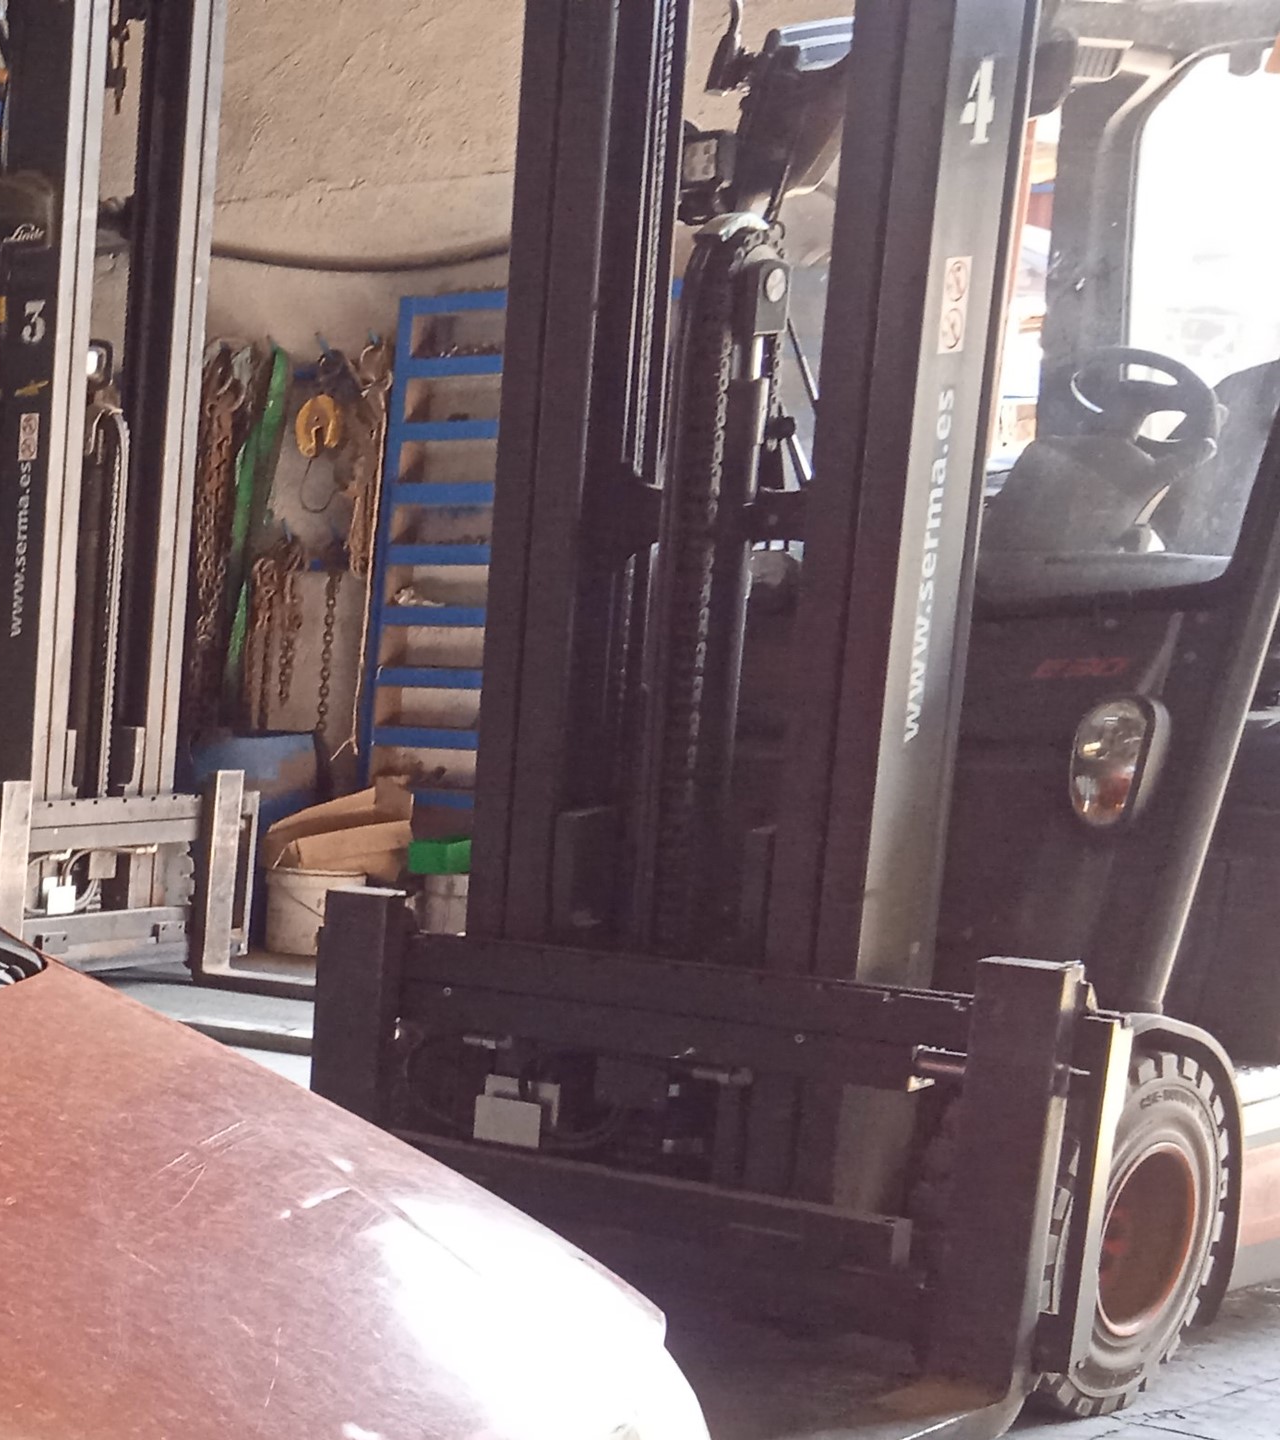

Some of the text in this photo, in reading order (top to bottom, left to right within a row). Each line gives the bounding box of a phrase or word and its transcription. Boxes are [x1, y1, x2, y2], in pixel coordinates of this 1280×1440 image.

[959, 57, 996, 145] 4
[22, 299, 46, 343] 3
[10, 461, 32, 638] www.serma.es
[903, 387, 955, 743] www.serma.es
